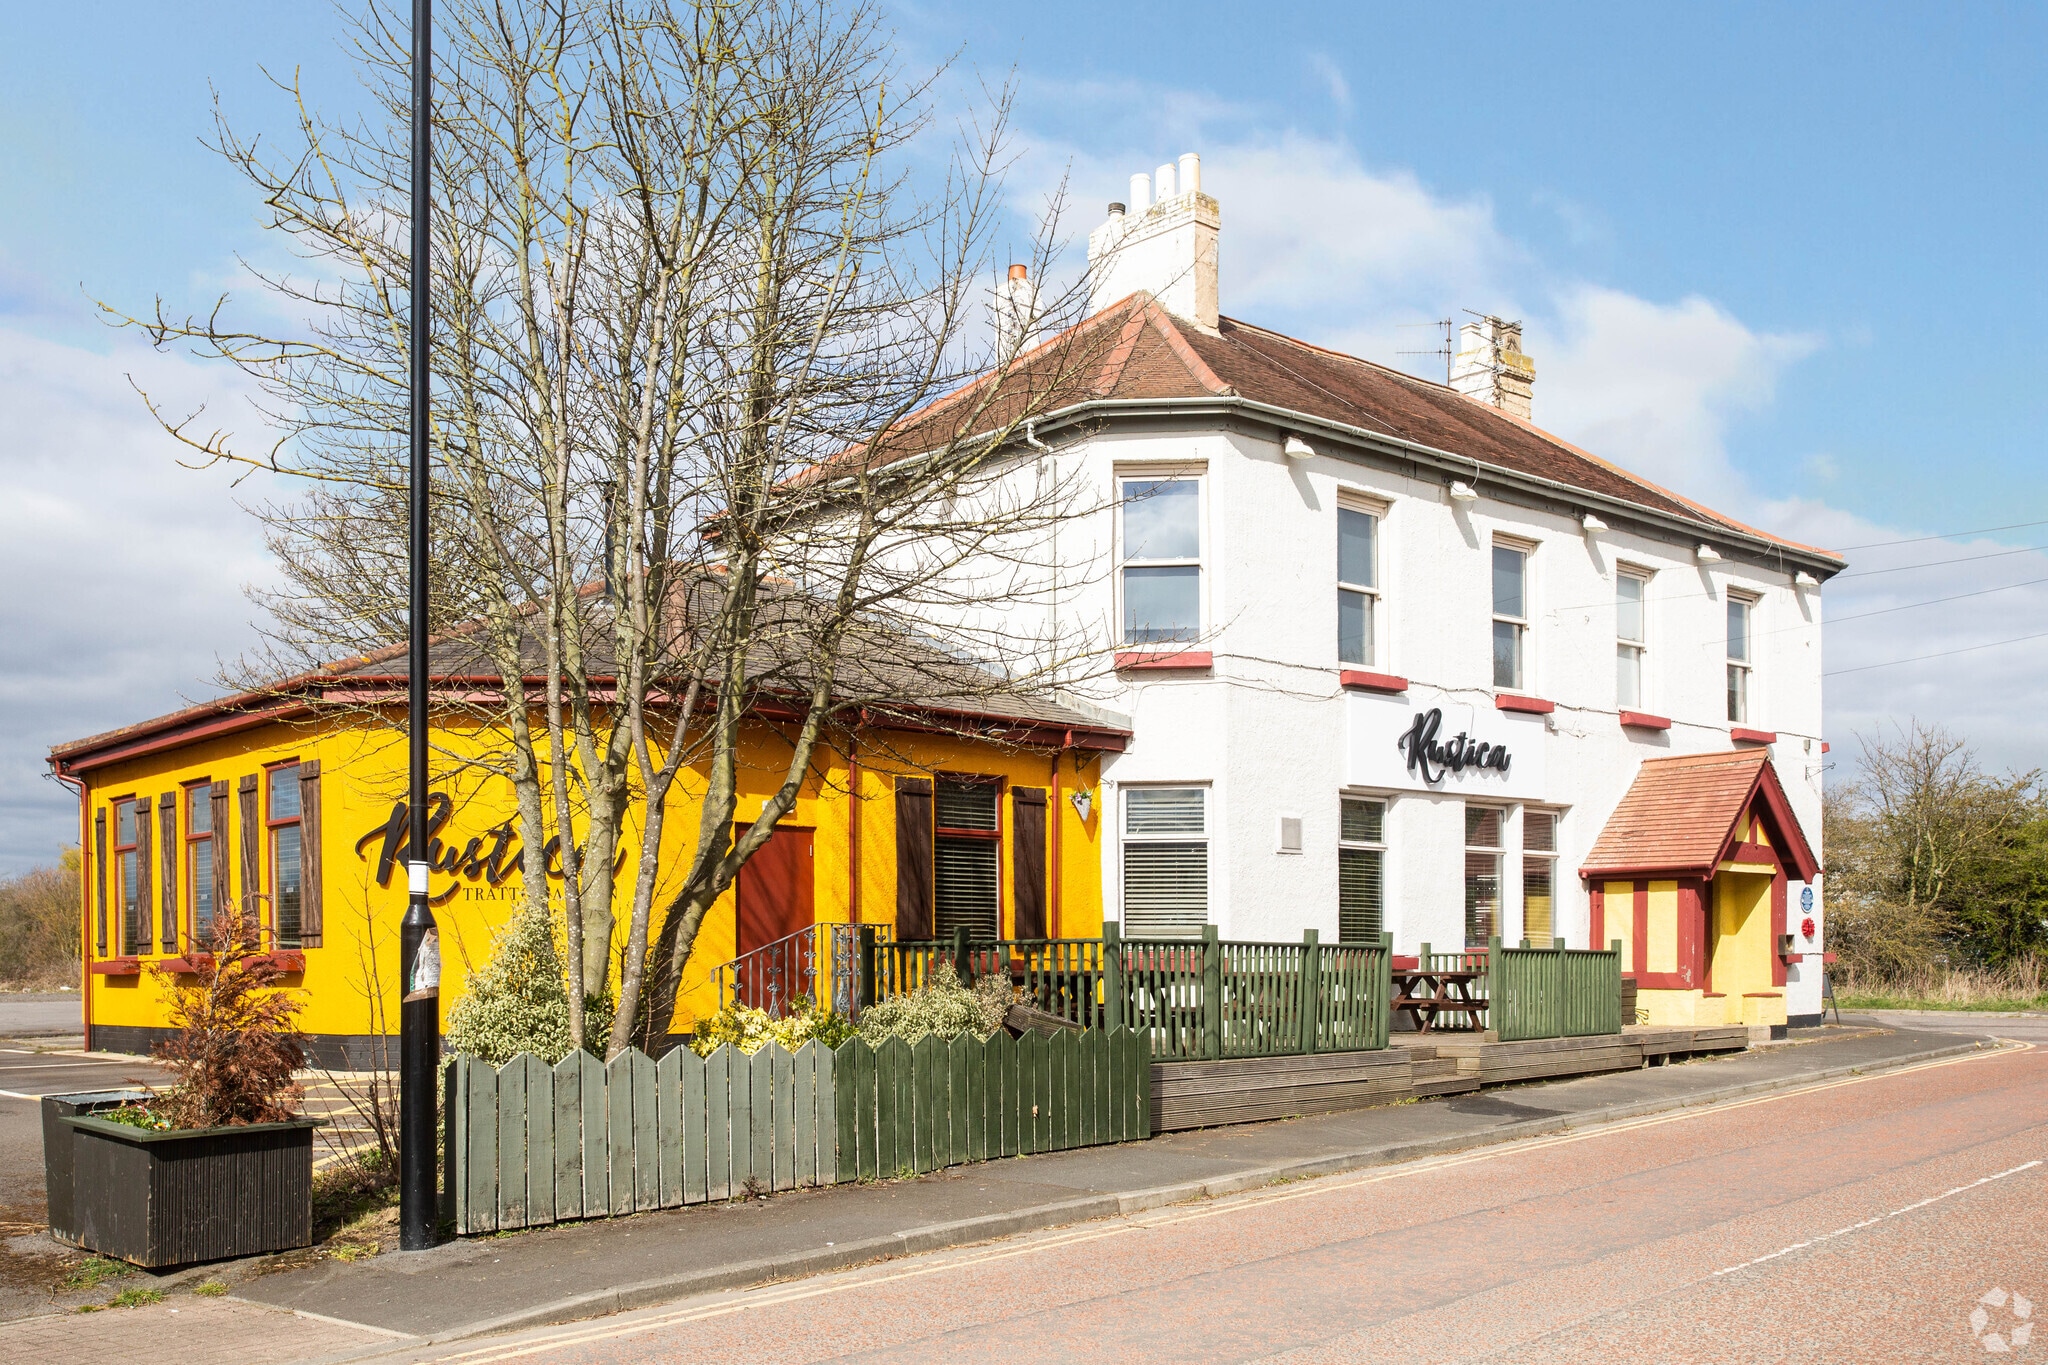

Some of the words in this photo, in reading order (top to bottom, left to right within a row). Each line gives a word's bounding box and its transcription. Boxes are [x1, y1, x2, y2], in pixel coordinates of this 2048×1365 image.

[1397, 708, 1512, 784] Rustica
[355, 792, 625, 902] Rustc
[463, 886, 563, 901] TRATTA
